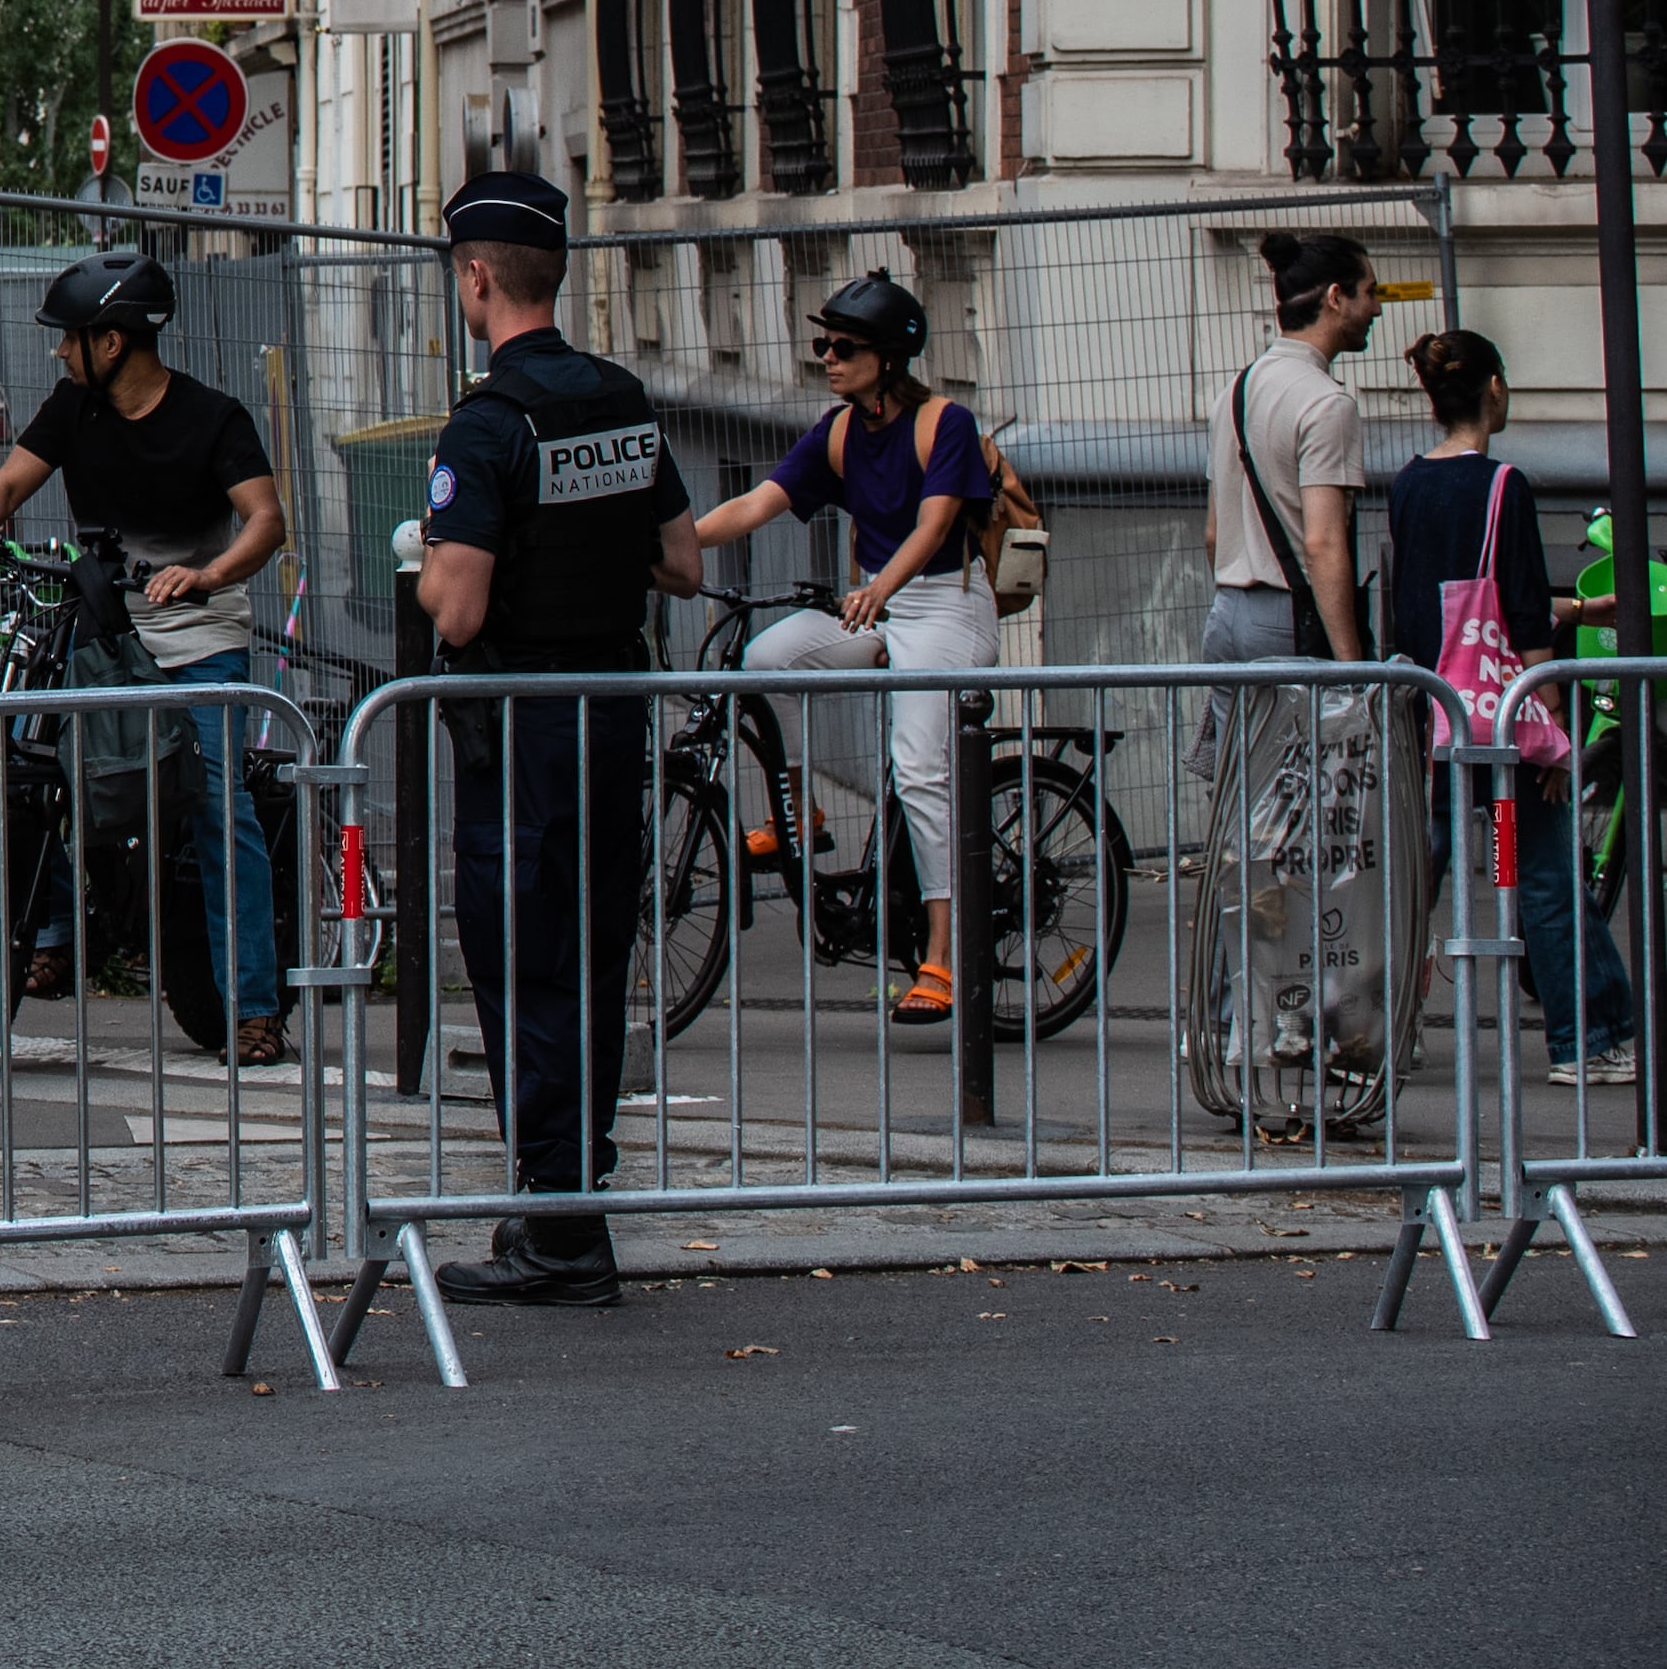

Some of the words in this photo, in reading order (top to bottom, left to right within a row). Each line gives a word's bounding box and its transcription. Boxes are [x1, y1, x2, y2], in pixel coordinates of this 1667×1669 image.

[140, 176, 189, 194] SAUF
[238, 202, 251, 215] 33
[255, 202, 267, 215] 33
[271, 202, 285, 215] 63
[550, 432, 656, 476] POLICE
[550, 463, 658, 495] NATIONALE
[1298, 950, 1360, 969] PRIS
[1278, 989, 1309, 1007] NF
